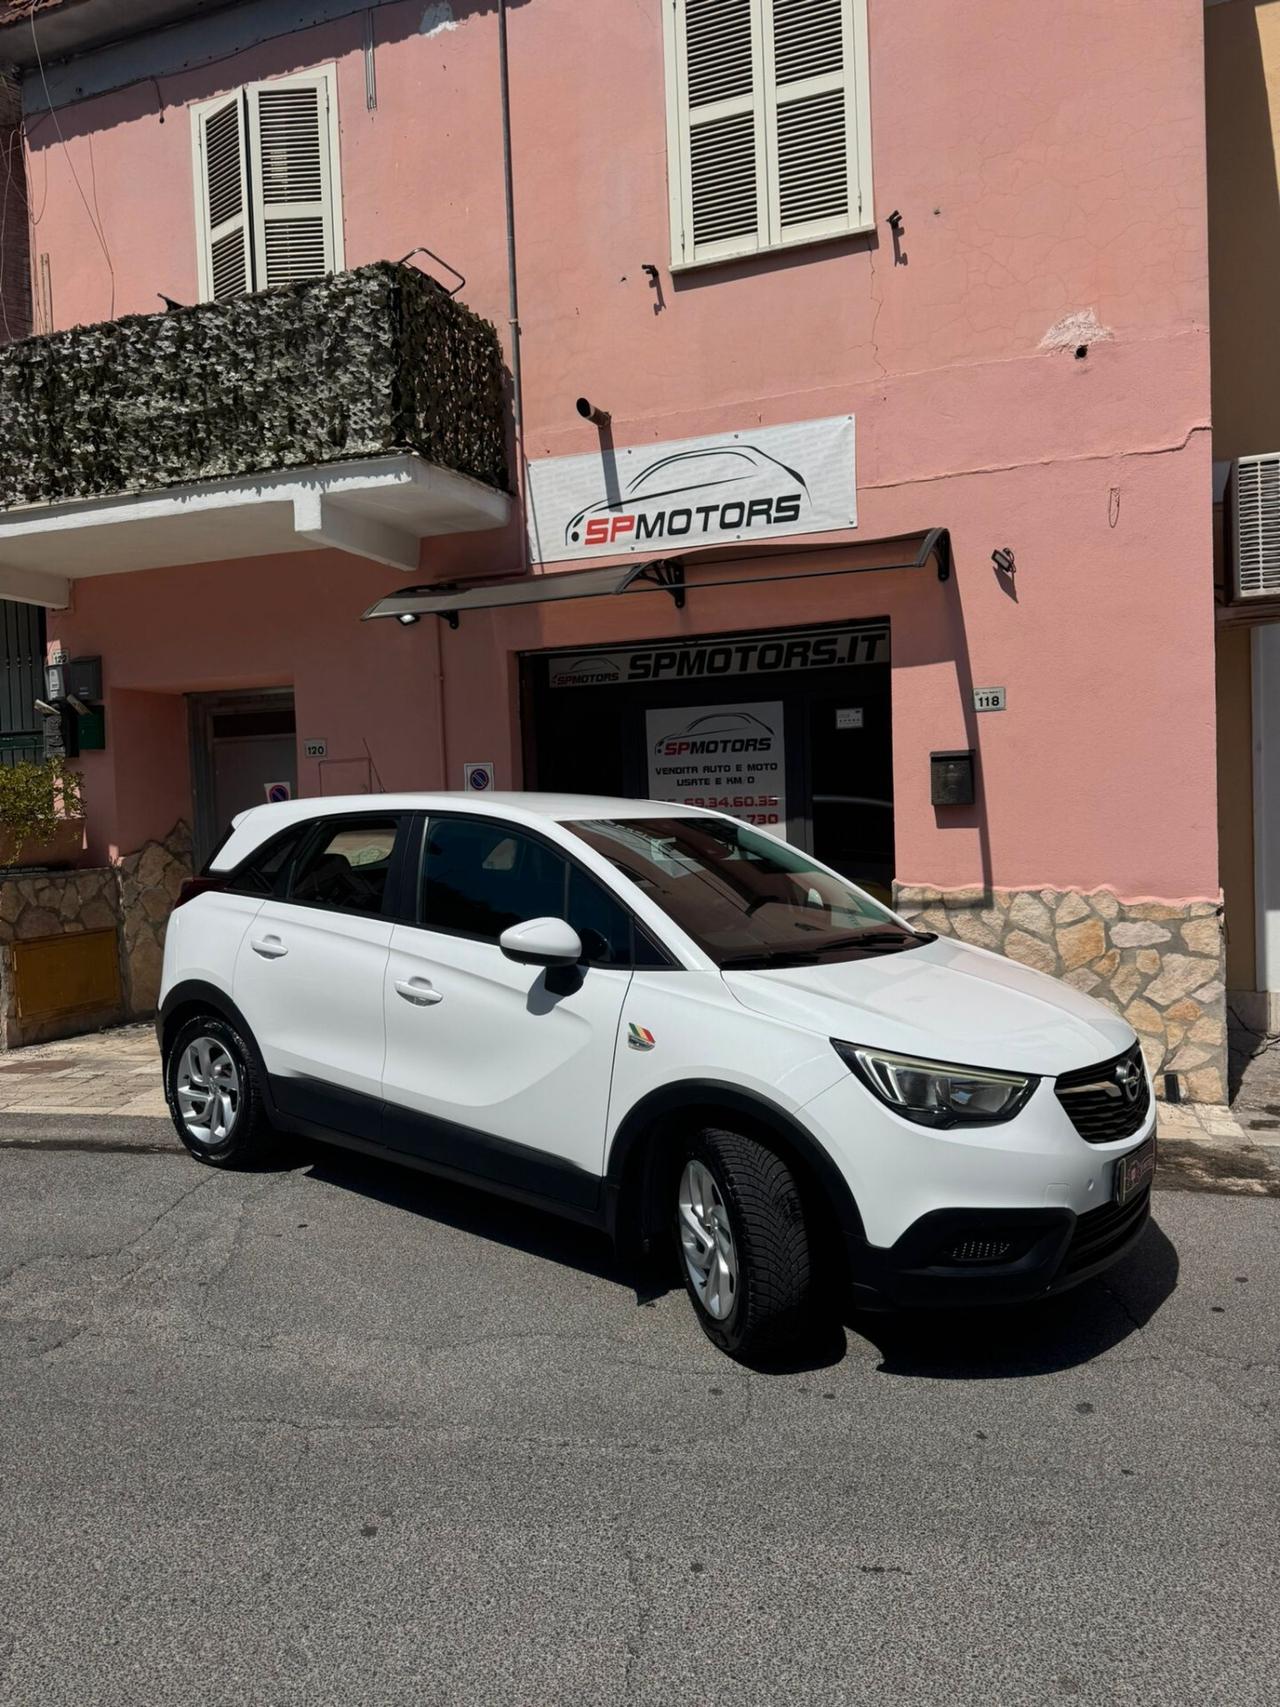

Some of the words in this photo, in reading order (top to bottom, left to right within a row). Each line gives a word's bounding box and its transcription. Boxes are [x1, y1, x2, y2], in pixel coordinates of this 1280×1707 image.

[584, 494, 802, 545] SPMOTORS
[627, 634, 886, 680] SPMOTORS.IT
[556, 671, 620, 686] SPMOTORS
[978, 695, 1000, 707] 118
[308, 746, 324, 755] 120
[664, 738, 772, 755] SPMOTORS
[655, 766, 698, 776] VENDITA
[703, 764, 731, 774] AUTO
[736, 763, 743, 772] E
[747, 762, 778, 771] MOTO
[677, 777, 711, 787] USATE
[715, 777, 722, 785] E
[726, 776, 742, 784] KM
